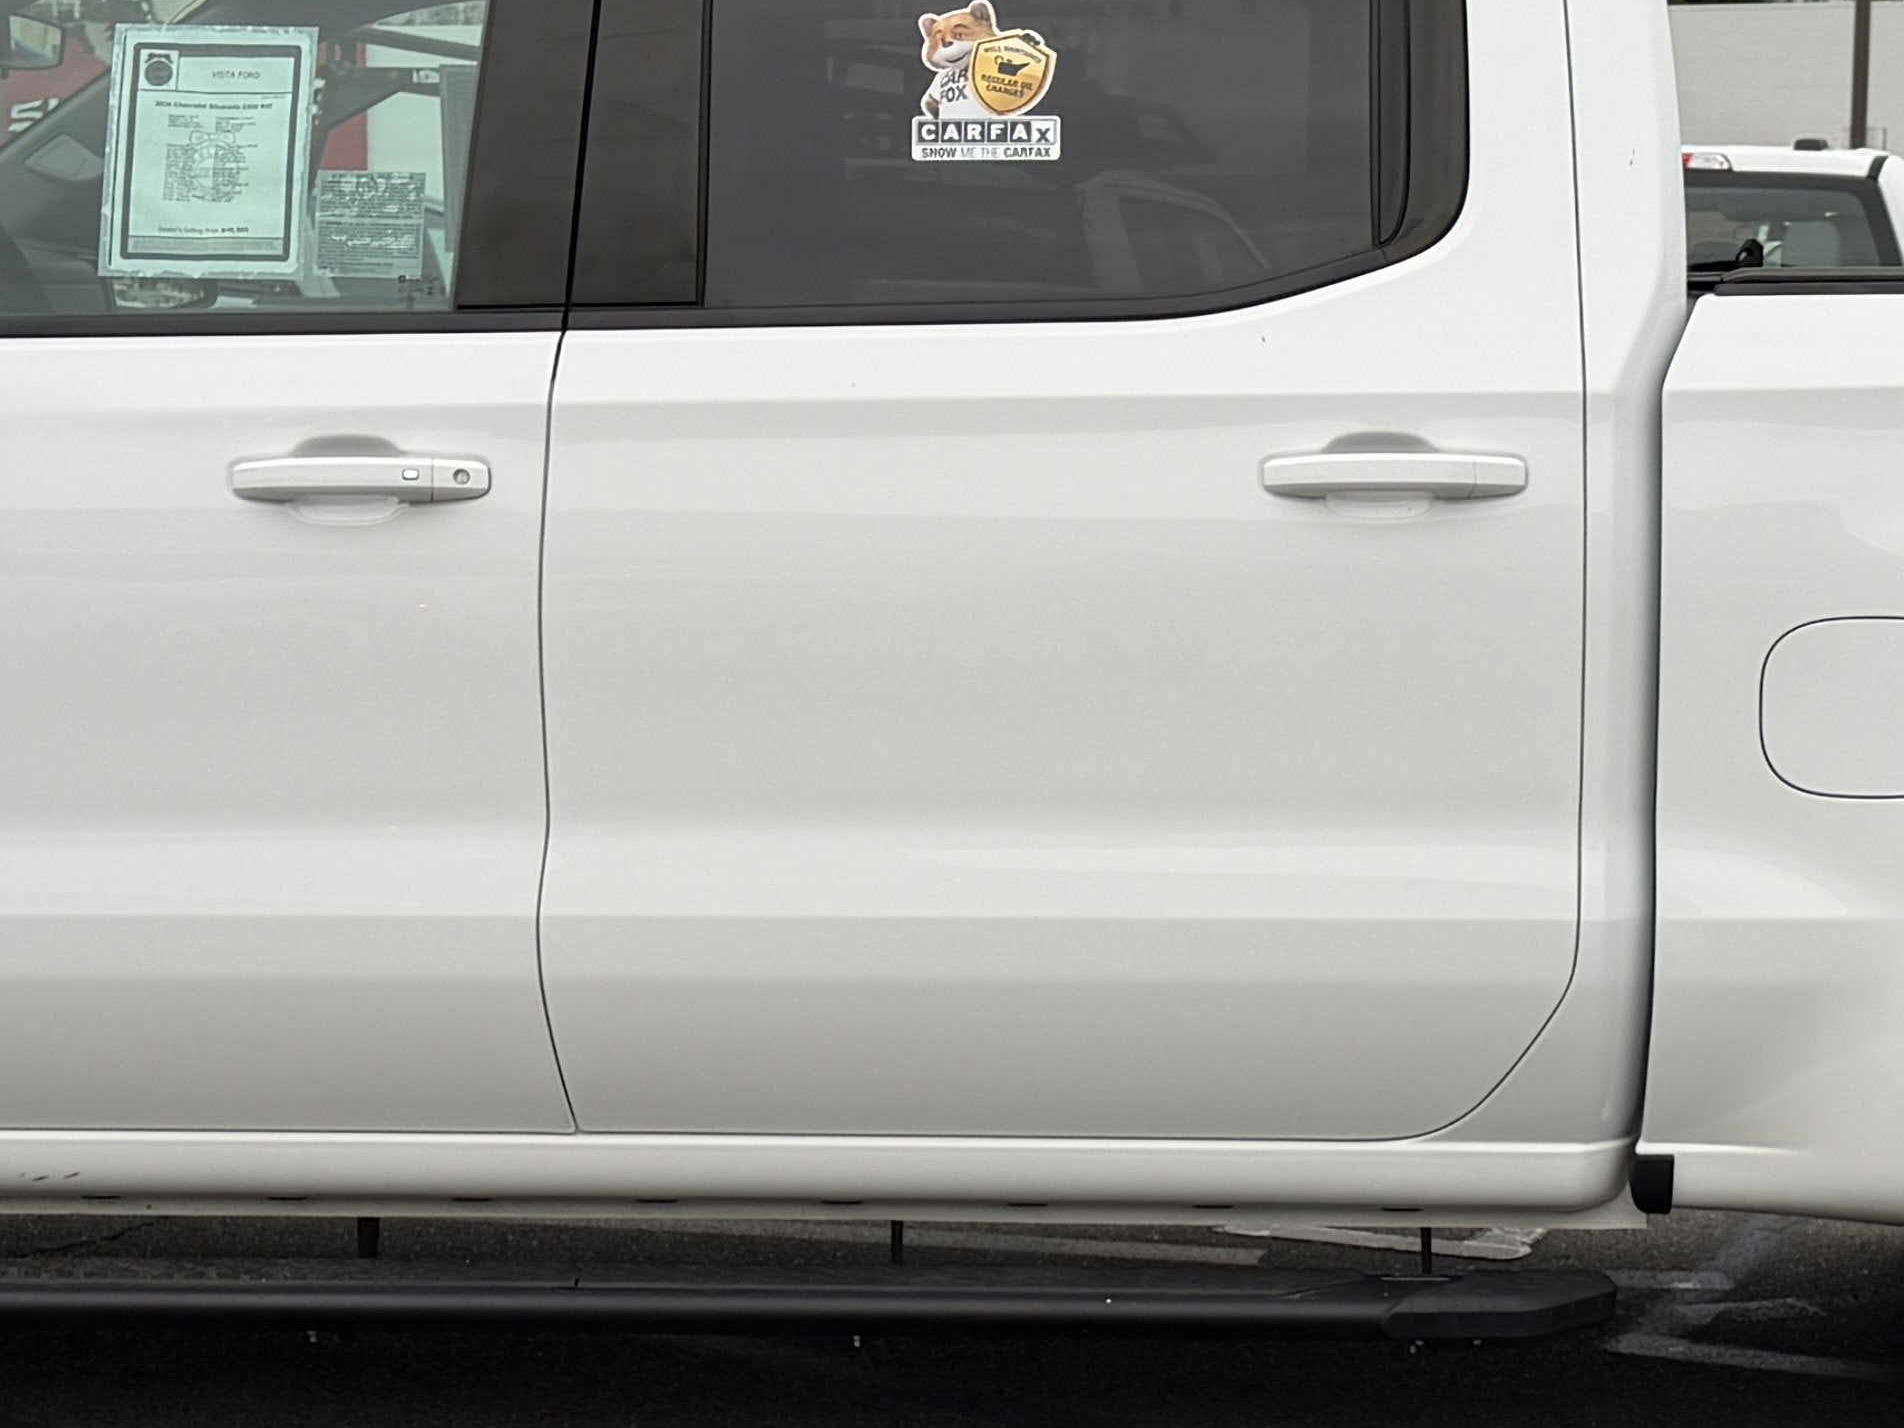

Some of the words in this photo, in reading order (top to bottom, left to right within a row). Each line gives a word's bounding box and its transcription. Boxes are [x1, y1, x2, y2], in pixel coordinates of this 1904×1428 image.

[940, 68, 968, 88] CAR
[940, 84, 968, 103] FOX
[921, 123, 1051, 143] CARFAX
[921, 147, 957, 158] SHOW
[1003, 147, 1051, 158] CARFAX
